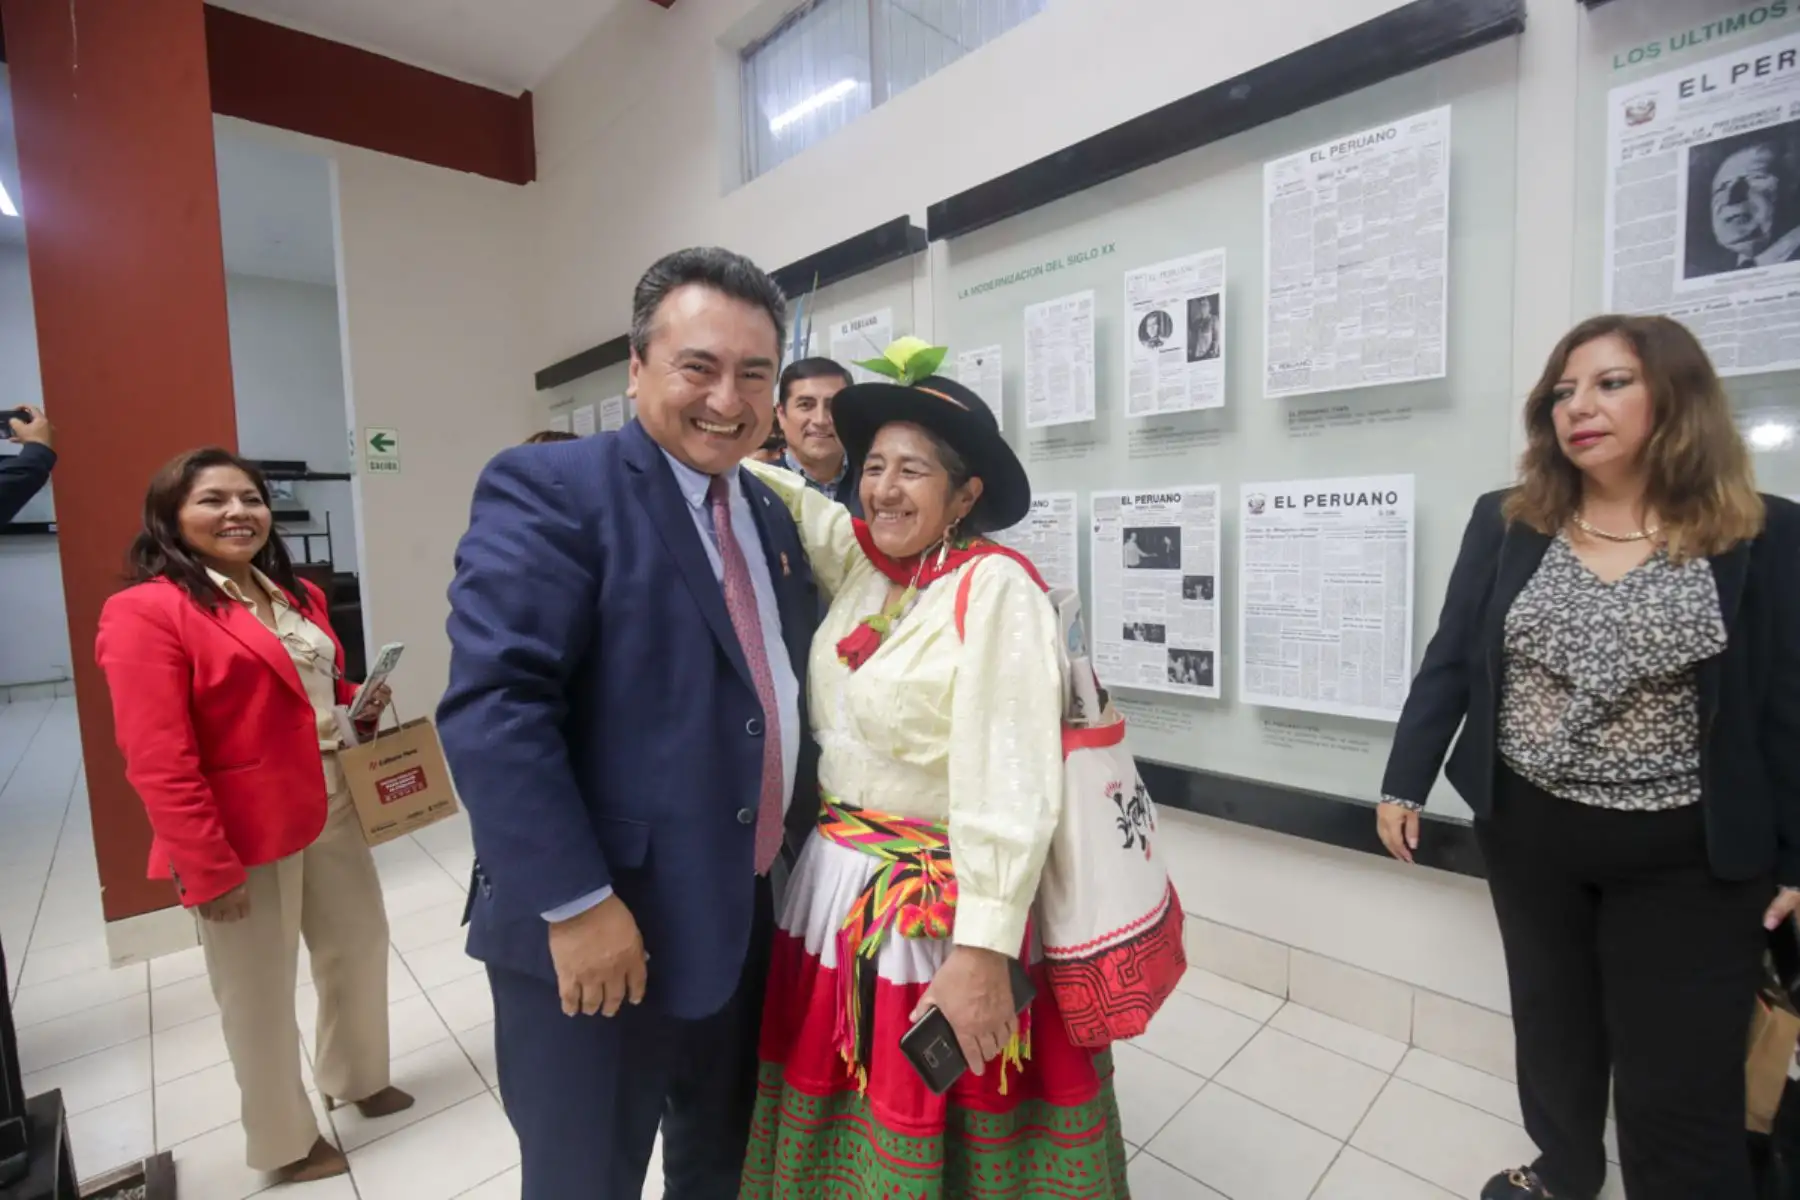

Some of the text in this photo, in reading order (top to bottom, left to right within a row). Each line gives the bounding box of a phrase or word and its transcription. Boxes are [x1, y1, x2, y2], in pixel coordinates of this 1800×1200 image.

[1613, 0, 1788, 70] LOS ULTIMOS
[1678, 74, 1717, 99] EL
[1309, 128, 1397, 164] EL PERUANO
[957, 242, 1117, 301] LA MODERNIZACION DEL SIGLO XX
[370, 461, 398, 470] SALIDA
[1121, 492, 1182, 506] EL PERUANO
[1274, 491, 1399, 509] EL PERUANO
